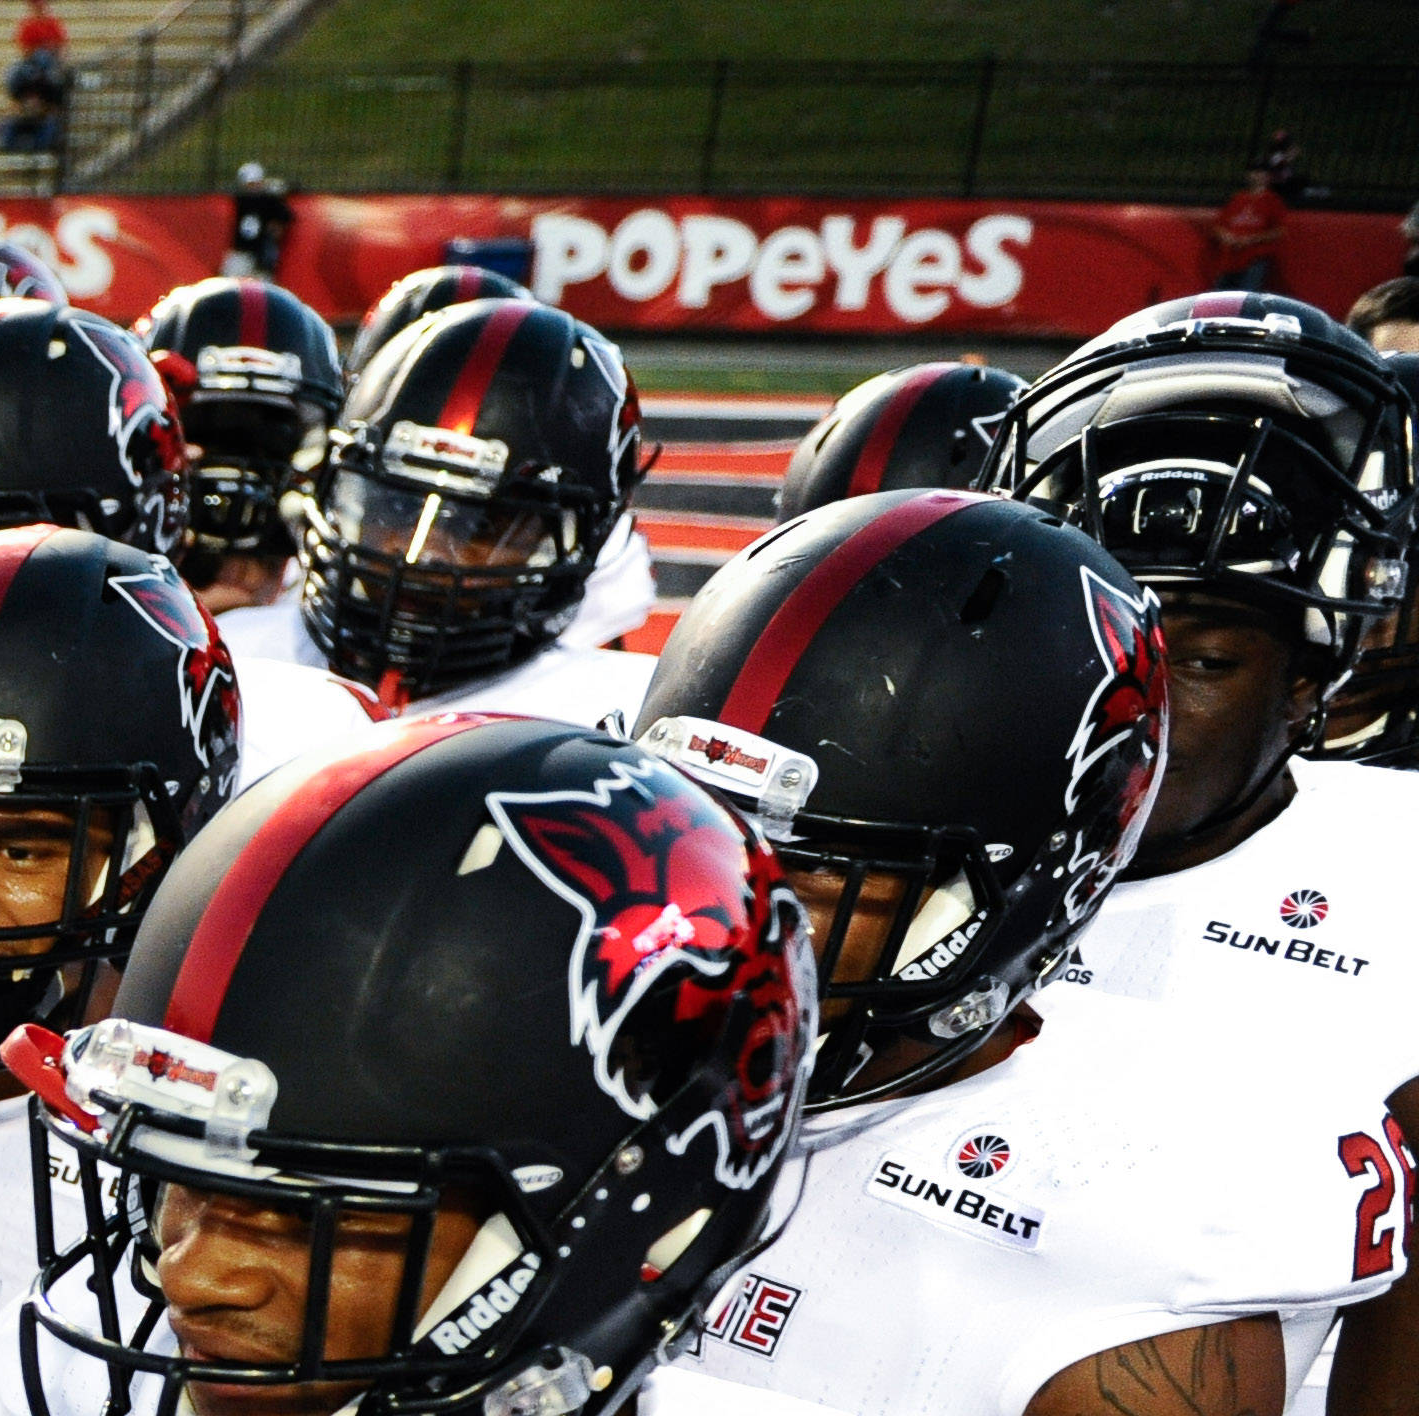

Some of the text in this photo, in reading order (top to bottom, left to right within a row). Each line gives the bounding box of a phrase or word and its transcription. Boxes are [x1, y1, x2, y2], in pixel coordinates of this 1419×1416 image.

[1203, 920, 1370, 976] SUN BELT
[874, 1160, 1041, 1239] SUN BELT
